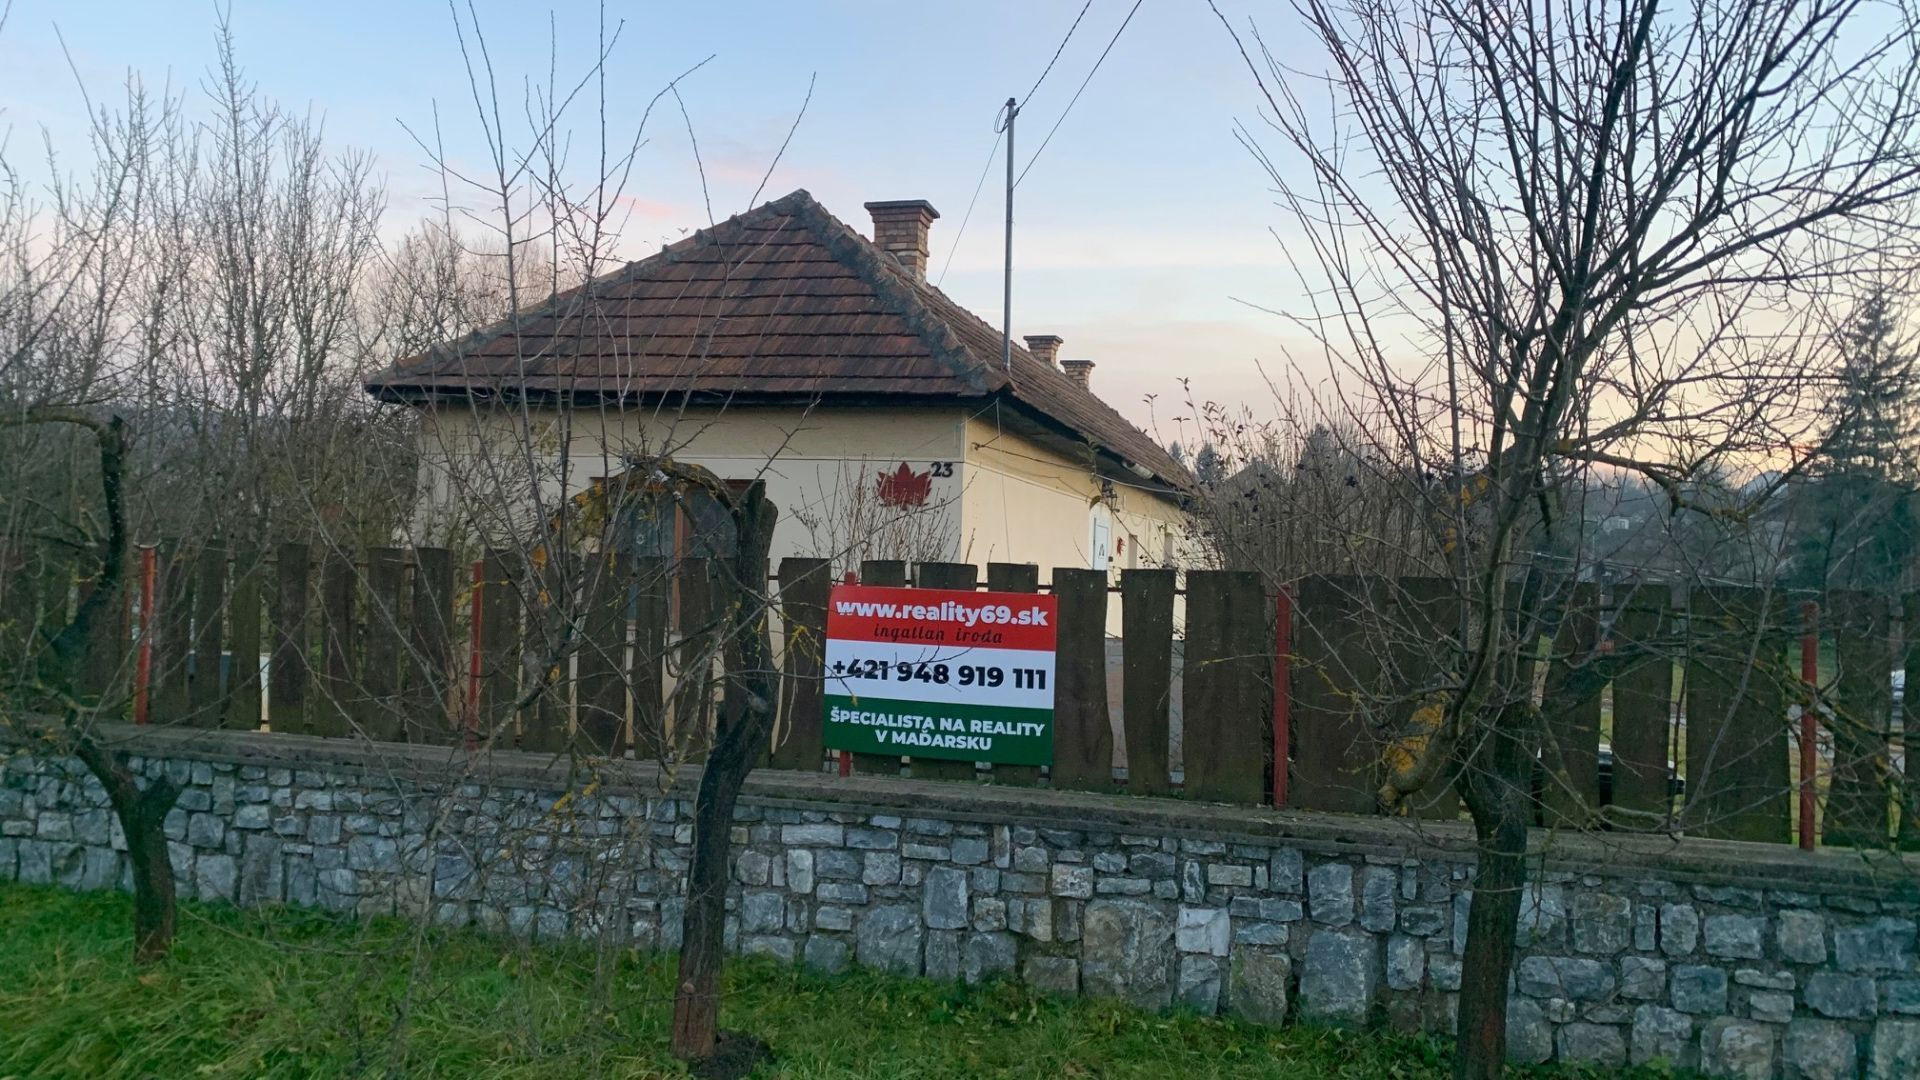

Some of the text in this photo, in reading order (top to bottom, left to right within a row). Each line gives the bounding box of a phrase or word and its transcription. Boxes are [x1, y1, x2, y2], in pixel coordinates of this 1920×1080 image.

[931, 461, 953, 478] 23
[836, 600, 1049, 627] www.reality69.sk
[955, 627, 1003, 644] iroda
[832, 658, 1047, 690] +421 948 919 111
[830, 706, 1046, 737] ŠPECIALISTA NA REALITY
[875, 729, 992, 751] V MAĎARSKU
